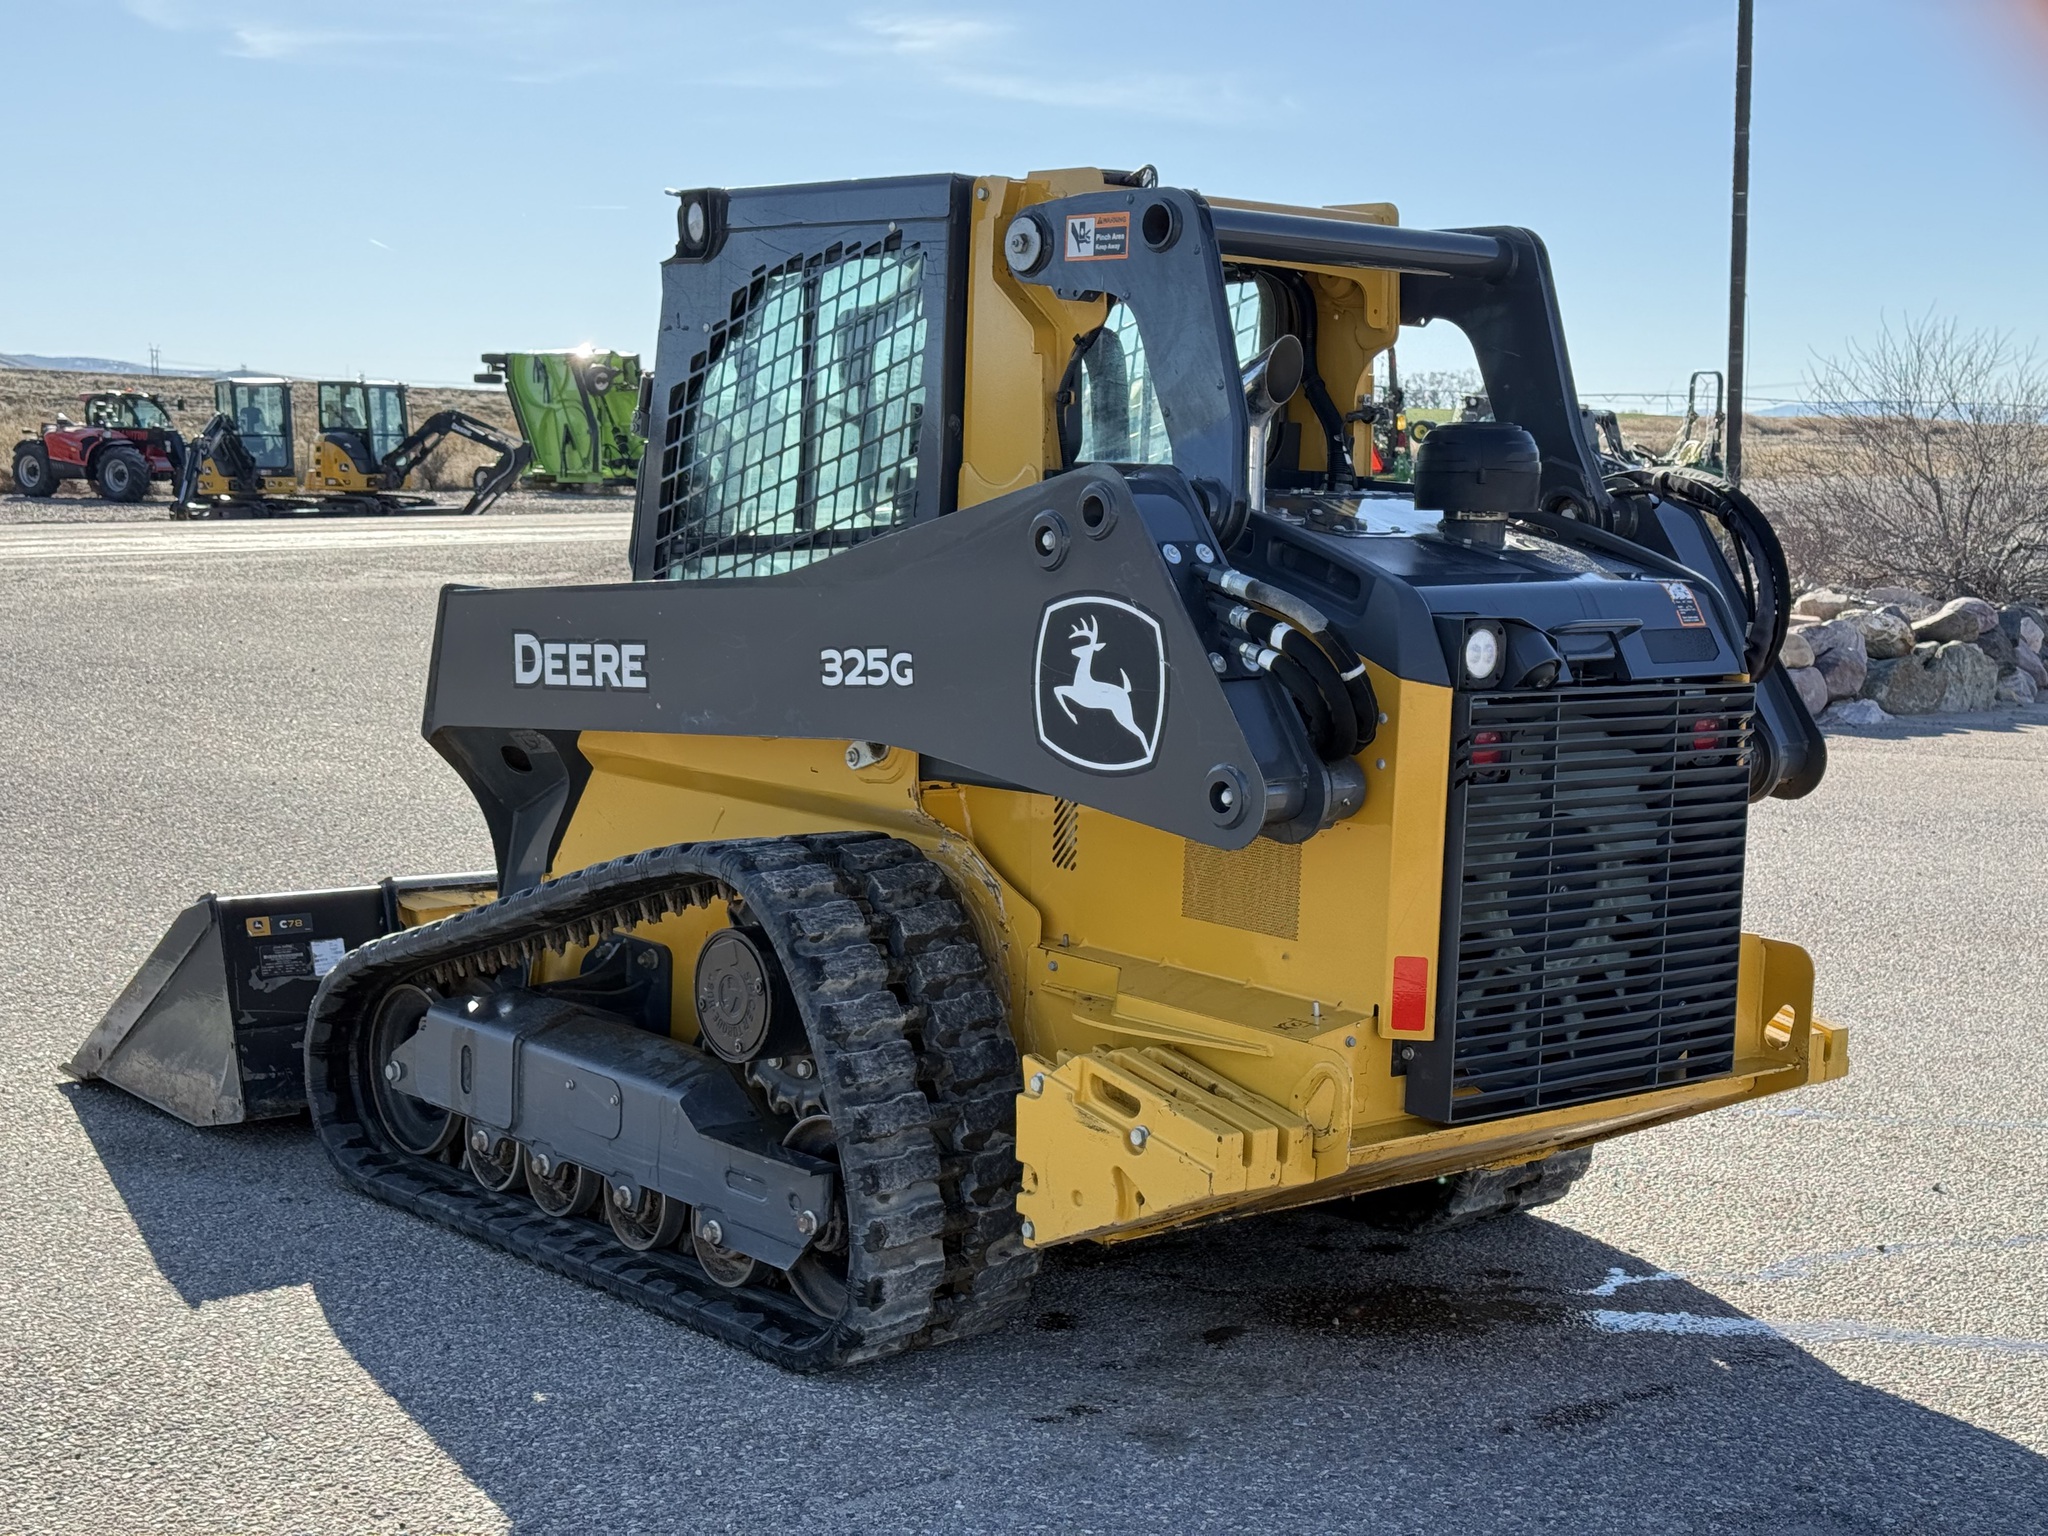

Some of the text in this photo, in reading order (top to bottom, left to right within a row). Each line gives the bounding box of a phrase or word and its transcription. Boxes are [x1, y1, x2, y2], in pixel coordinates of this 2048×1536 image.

[1112, 232, 1125, 240] Area
[514, 633, 647, 688] DEERE
[821, 648, 914, 686] 325G
[279, 919, 303, 929] C78
